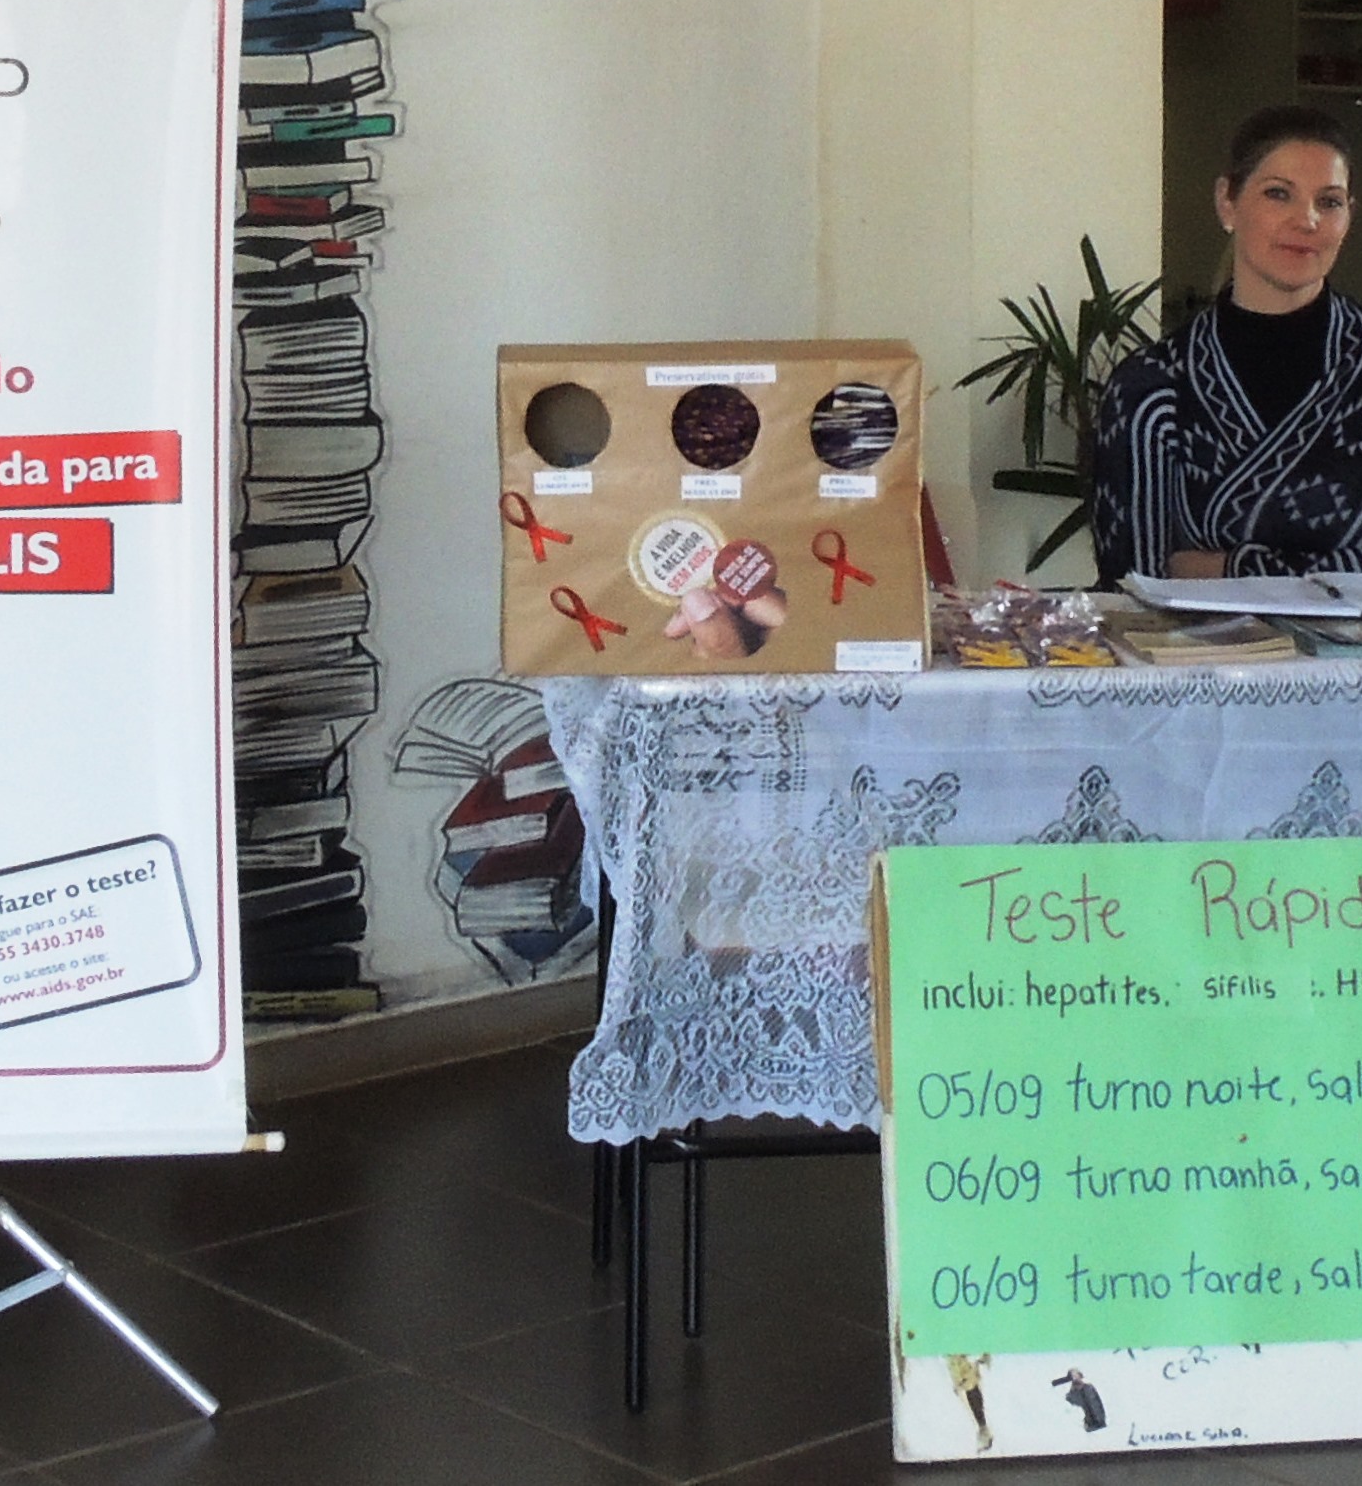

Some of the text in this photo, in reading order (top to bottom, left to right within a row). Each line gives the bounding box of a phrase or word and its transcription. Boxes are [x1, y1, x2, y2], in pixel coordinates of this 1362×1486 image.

[62, 452, 159, 492] para
[650, 528, 682, 562] A VIDA
[661, 531, 703, 574] MELHOR
[667, 567, 692, 593] SEM
[65, 883, 81, 899] o
[86, 859, 157, 893] teste?
[959, 866, 1126, 944] Teste
[21, 924, 105, 956] 3430.3748
[25, 917, 55, 936] para
[58, 915, 67, 926] o
[3, 973, 20, 985] ou
[24, 962, 66, 980] acesse
[70, 959, 79, 969] o
[918, 1067, 1043, 1120] 05/09
[1067, 1061, 1171, 1114] turno
[1185, 1064, 1297, 1109] noite,
[924, 1153, 1041, 1205] 06/09
[1066, 1155, 1171, 1200] turno
[1184, 1157, 1311, 1192] manhã,
[931, 1254, 1040, 1310] 06/09
[1065, 1253, 1171, 1304] turno
[1181, 1250, 1302, 1297] tarde,
